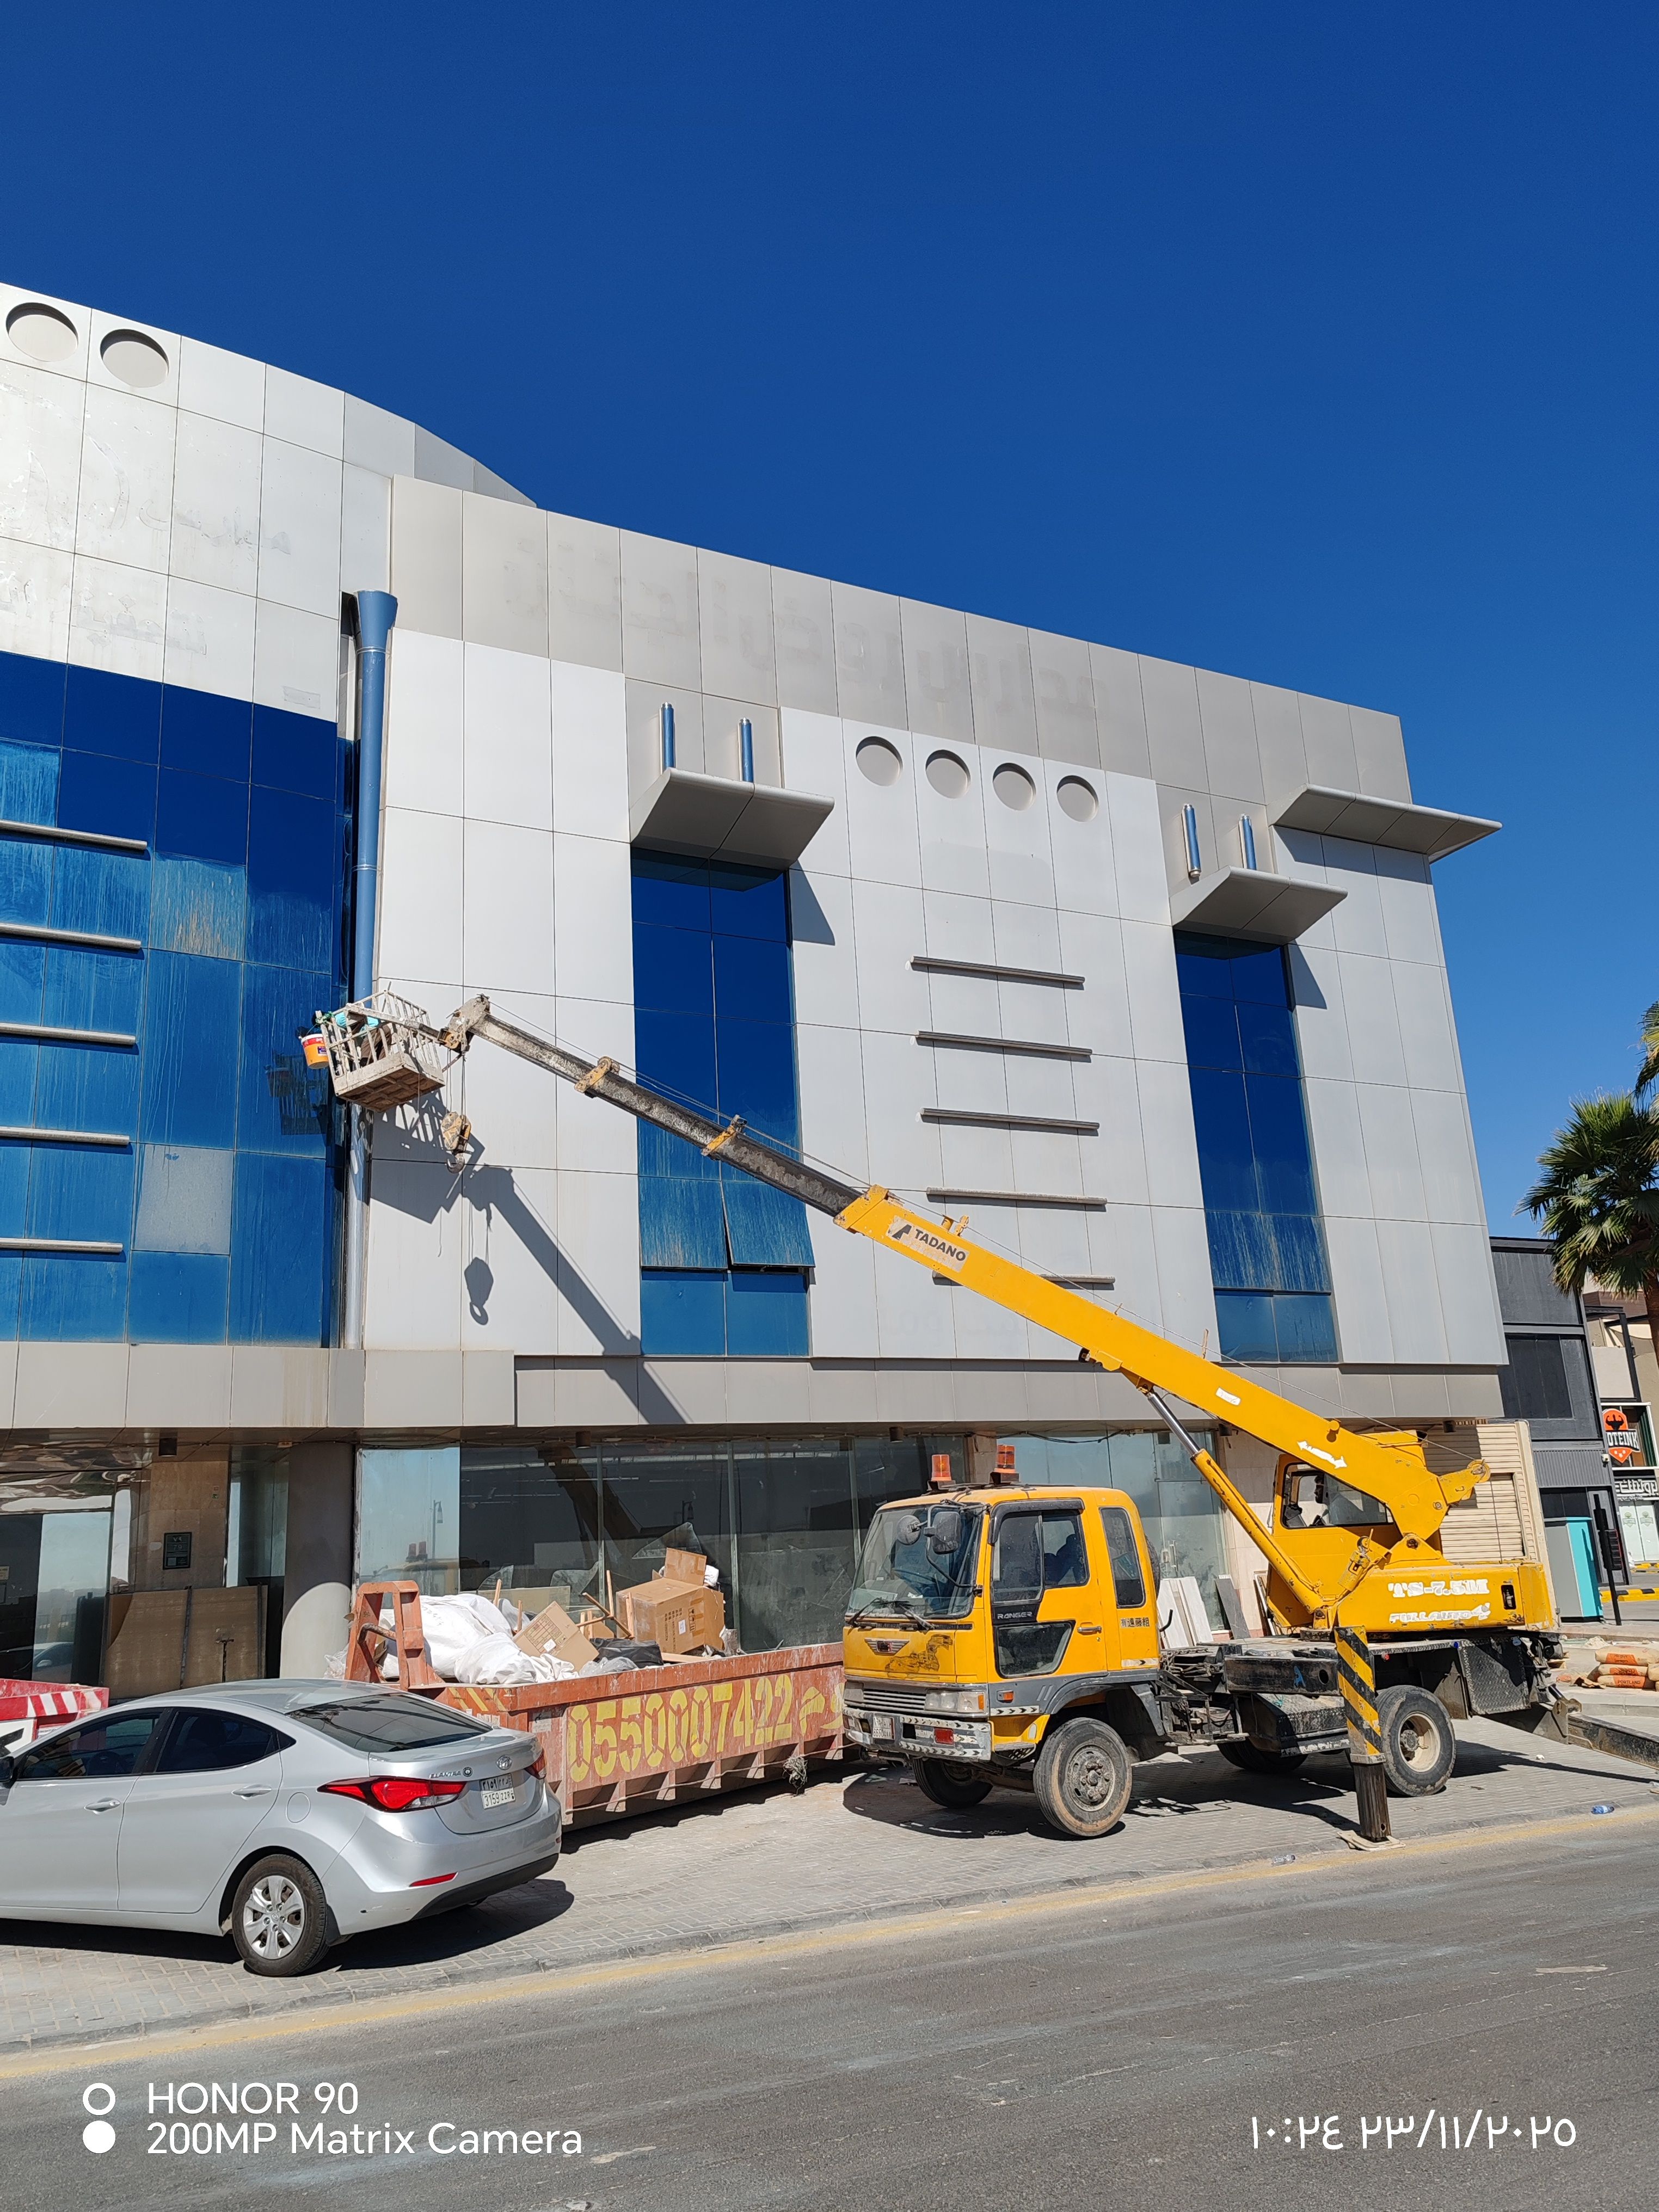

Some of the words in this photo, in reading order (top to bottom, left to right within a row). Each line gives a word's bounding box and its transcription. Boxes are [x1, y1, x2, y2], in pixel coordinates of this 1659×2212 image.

[915, 1228, 966, 1261] TADANO
[997, 1611, 1033, 1619] RANGER
[567, 1674, 792, 1783] 0550007422
[429, 1771, 461, 1779] ELANTRA
[484, 1792, 500, 1807] 3159
[501, 1791, 511, 1801] ZZR
